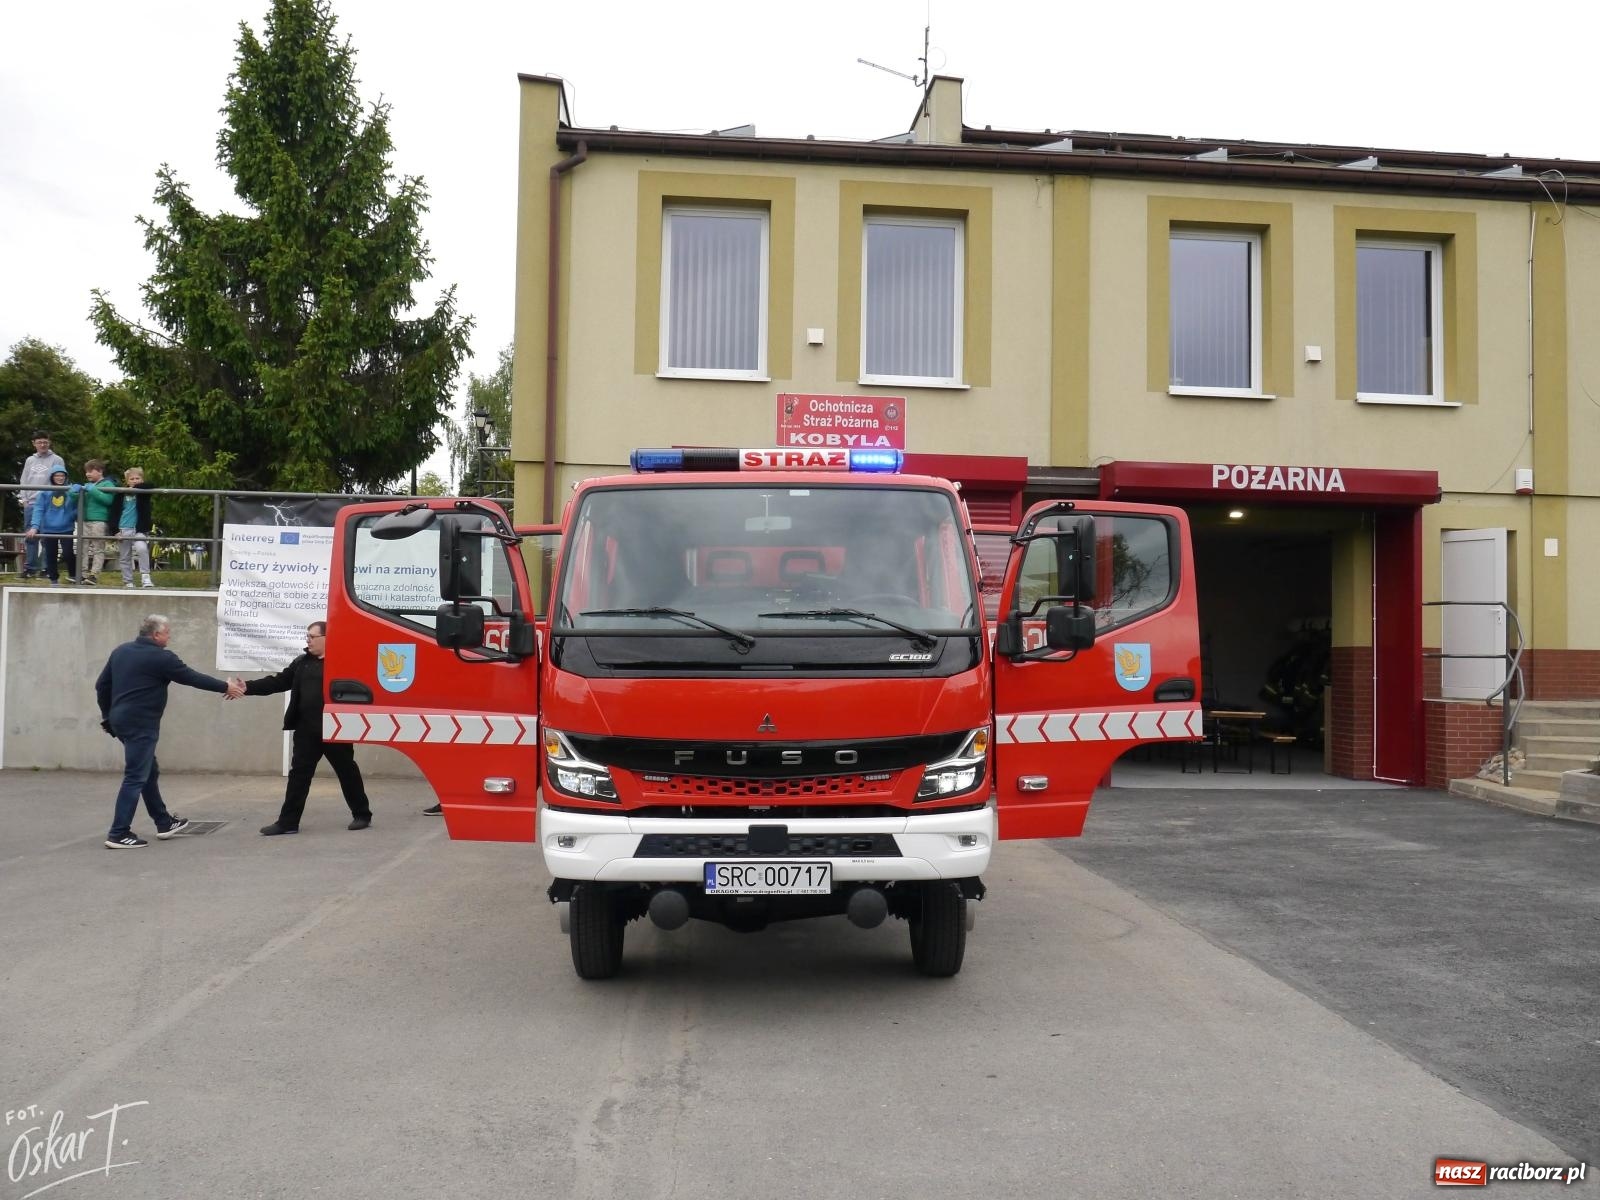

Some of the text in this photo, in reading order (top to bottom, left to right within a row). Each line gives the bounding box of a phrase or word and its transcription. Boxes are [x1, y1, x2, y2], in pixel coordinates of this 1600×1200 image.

[809, 399, 874, 414] Ochotnicza
[803, 414, 833, 427] Straż
[835, 414, 879, 428] Pożarna
[790, 432, 891, 447] KOBYLA
[231, 532, 275, 544] Interreg
[229, 560, 269, 573] Cztery
[272, 561, 319, 575] żywioły
[353, 564, 372, 574] owi
[376, 566, 390, 574] na
[393, 565, 437, 577] zmiany
[227, 579, 267, 589] Większa
[268, 580, 315, 590] gotowość
[393, 584, 435, 592] zdolność
[225, 589, 238, 597] do
[240, 589, 281, 598] radzenia
[283, 591, 309, 600] sobie
[224, 599, 237, 607] na
[240, 599, 292, 610] pograniczu
[294, 601, 327, 610] czesko
[223, 608, 259, 618] klimatu
[674, 749, 859, 766] FUSO
[717, 866, 828, 887] SRC 00717
